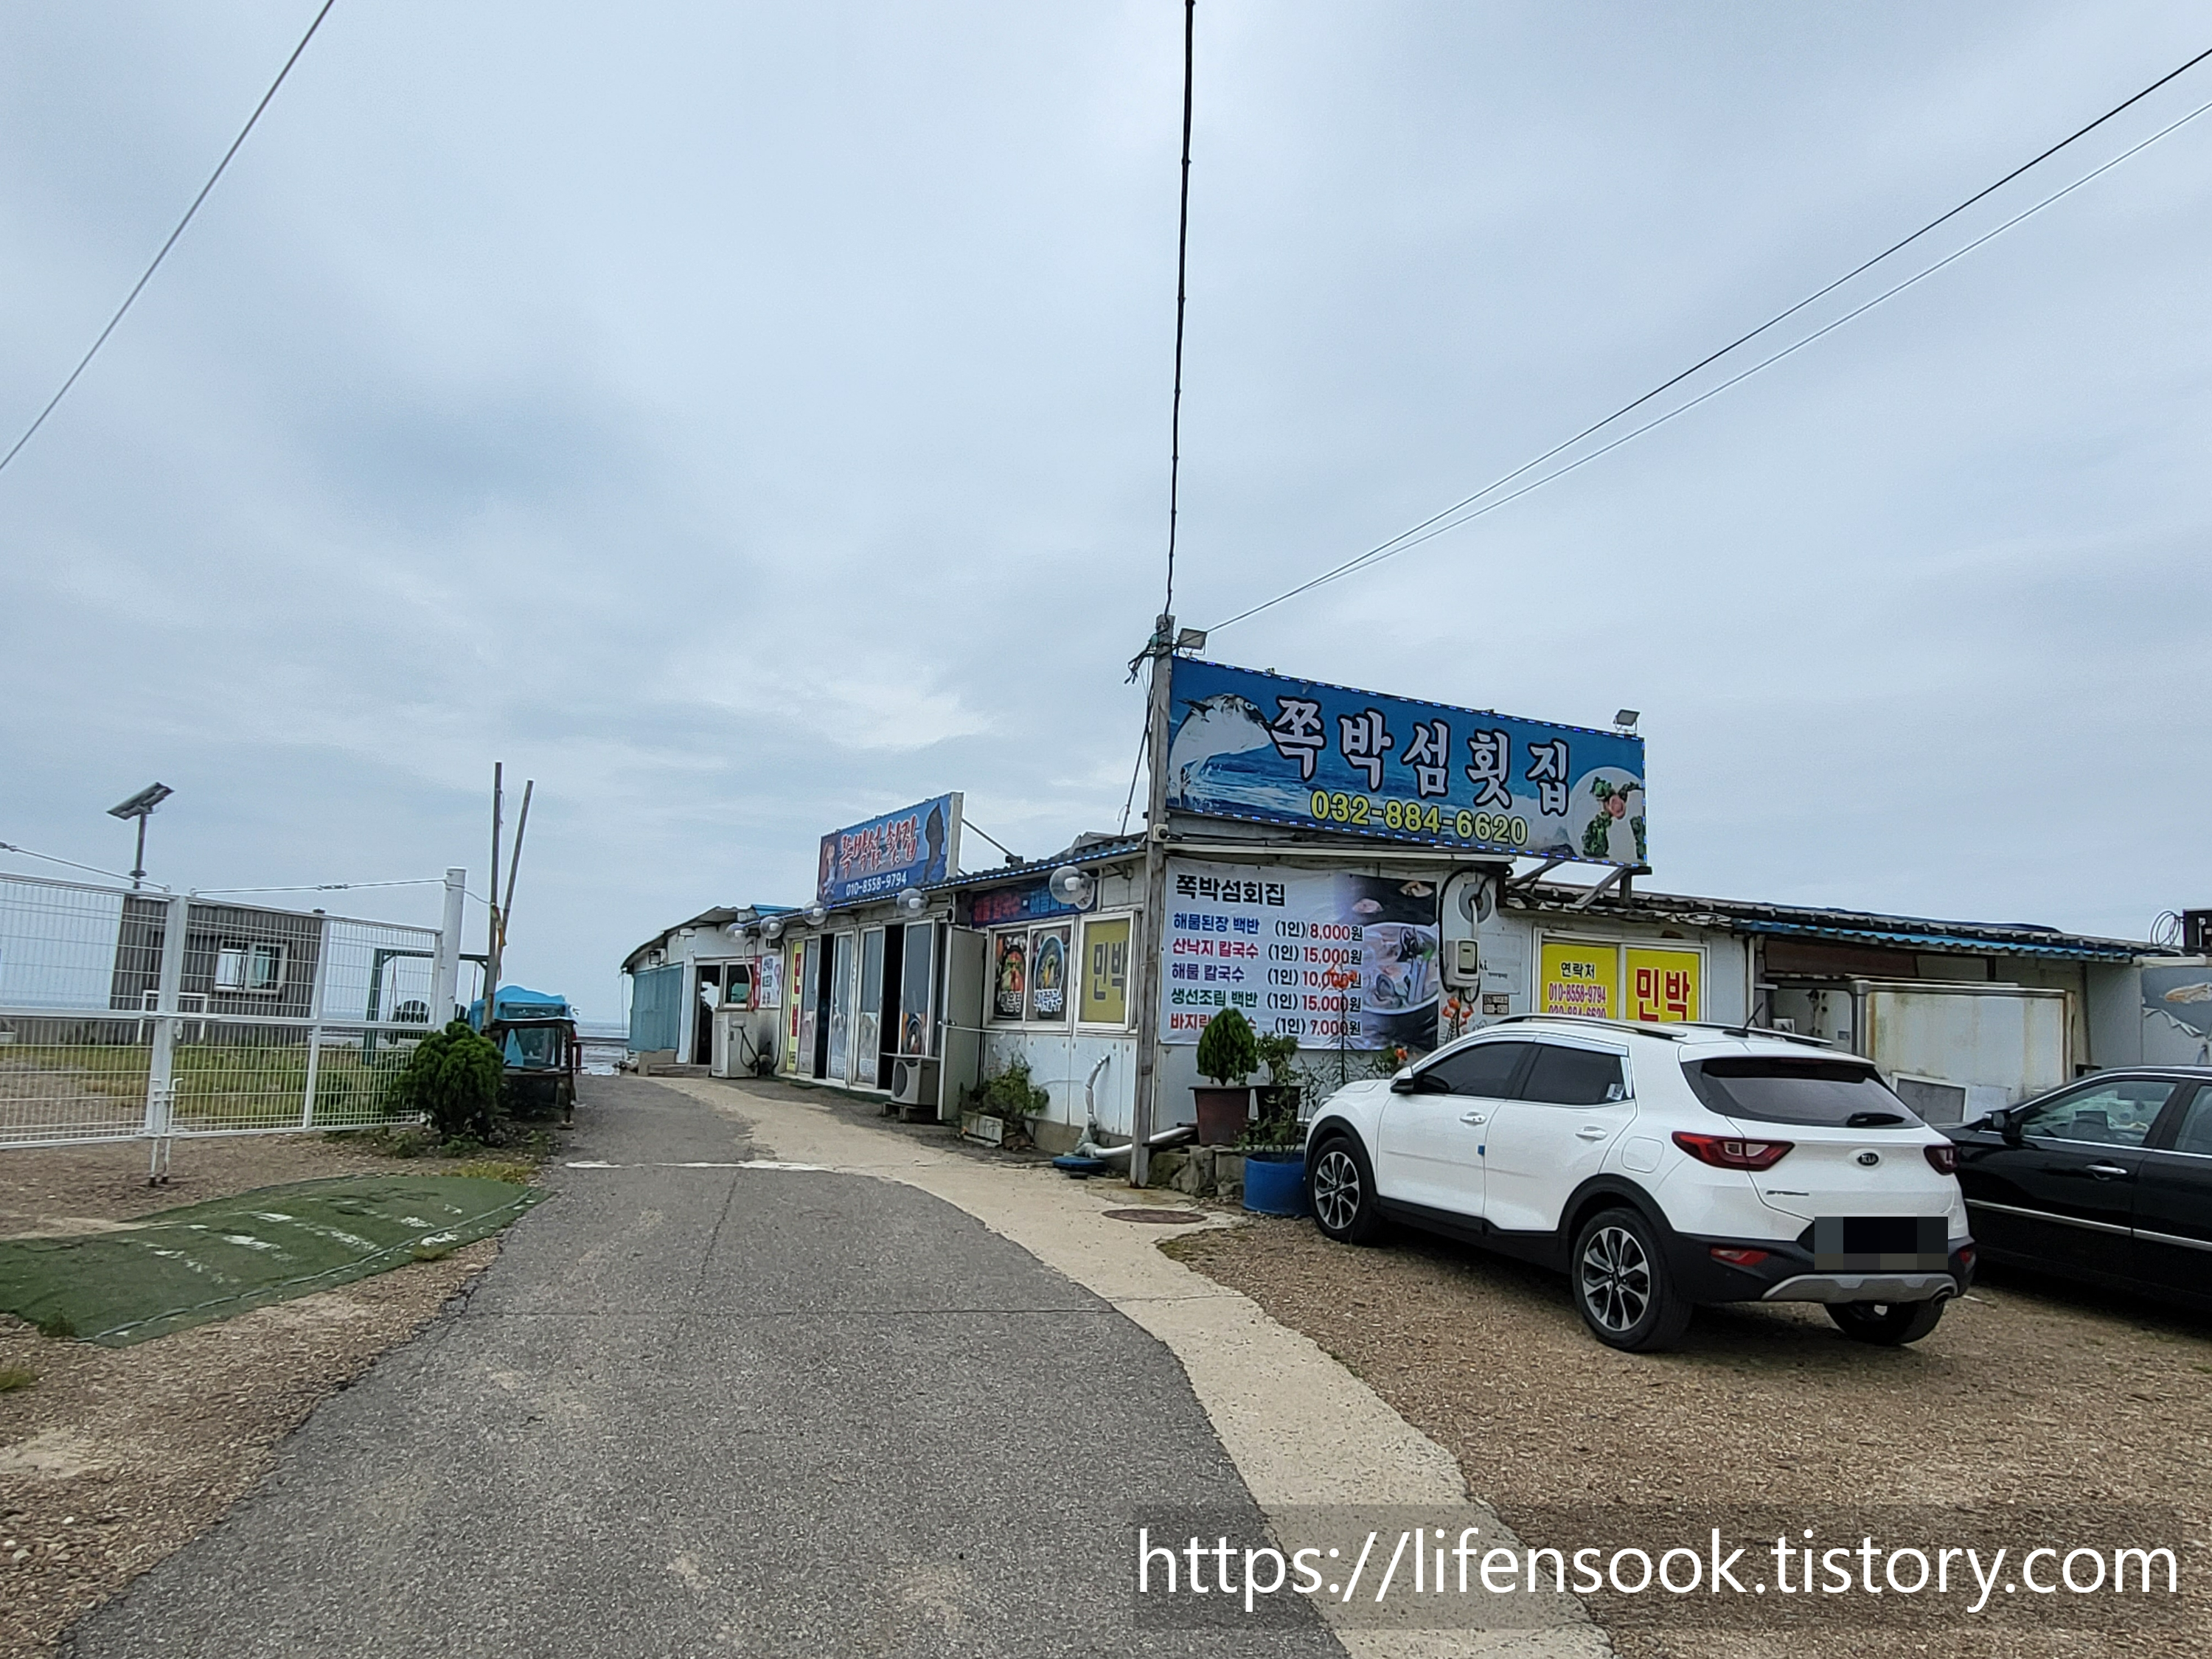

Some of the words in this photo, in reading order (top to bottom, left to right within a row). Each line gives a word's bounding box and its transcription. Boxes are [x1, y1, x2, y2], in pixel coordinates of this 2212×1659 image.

[1311, 790, 1527, 845] 032-884-6620
[846, 871, 907, 897] 010-8558-9794
[1176, 874, 1286, 906] 쪽박섬회집
[1173, 913, 1229, 932] 해물된장
[1233, 917, 1260, 934] 백반
[1275, 919, 1305, 938] (1인)
[1310, 923, 1363, 942] 8,000원
[1172, 938, 1214, 956] 산낙지
[1219, 941, 1259, 959] 칼국수
[1268, 944, 1299, 961] (1인)
[1303, 947, 1363, 965] 15,000원
[1094, 941, 1127, 1001] 민박
[1172, 962, 1199, 980] 해물
[1204, 964, 1245, 983] 칼국수
[1267, 968, 1298, 986] (1인)
[1561, 962, 1595, 979] 연락처
[1171, 988, 1226, 1006] 생선조림
[1231, 990, 1258, 1008] 백반
[1267, 992, 1298, 1010] (1인)
[1302, 995, 1362, 1013] 15,000원
[1549, 983, 1606, 1004] 010-8558-9794
[1637, 968, 1691, 1021] 민박
[1275, 1017, 1306, 1034] (1인)
[1310, 1020, 1362, 1036] 7,000원
